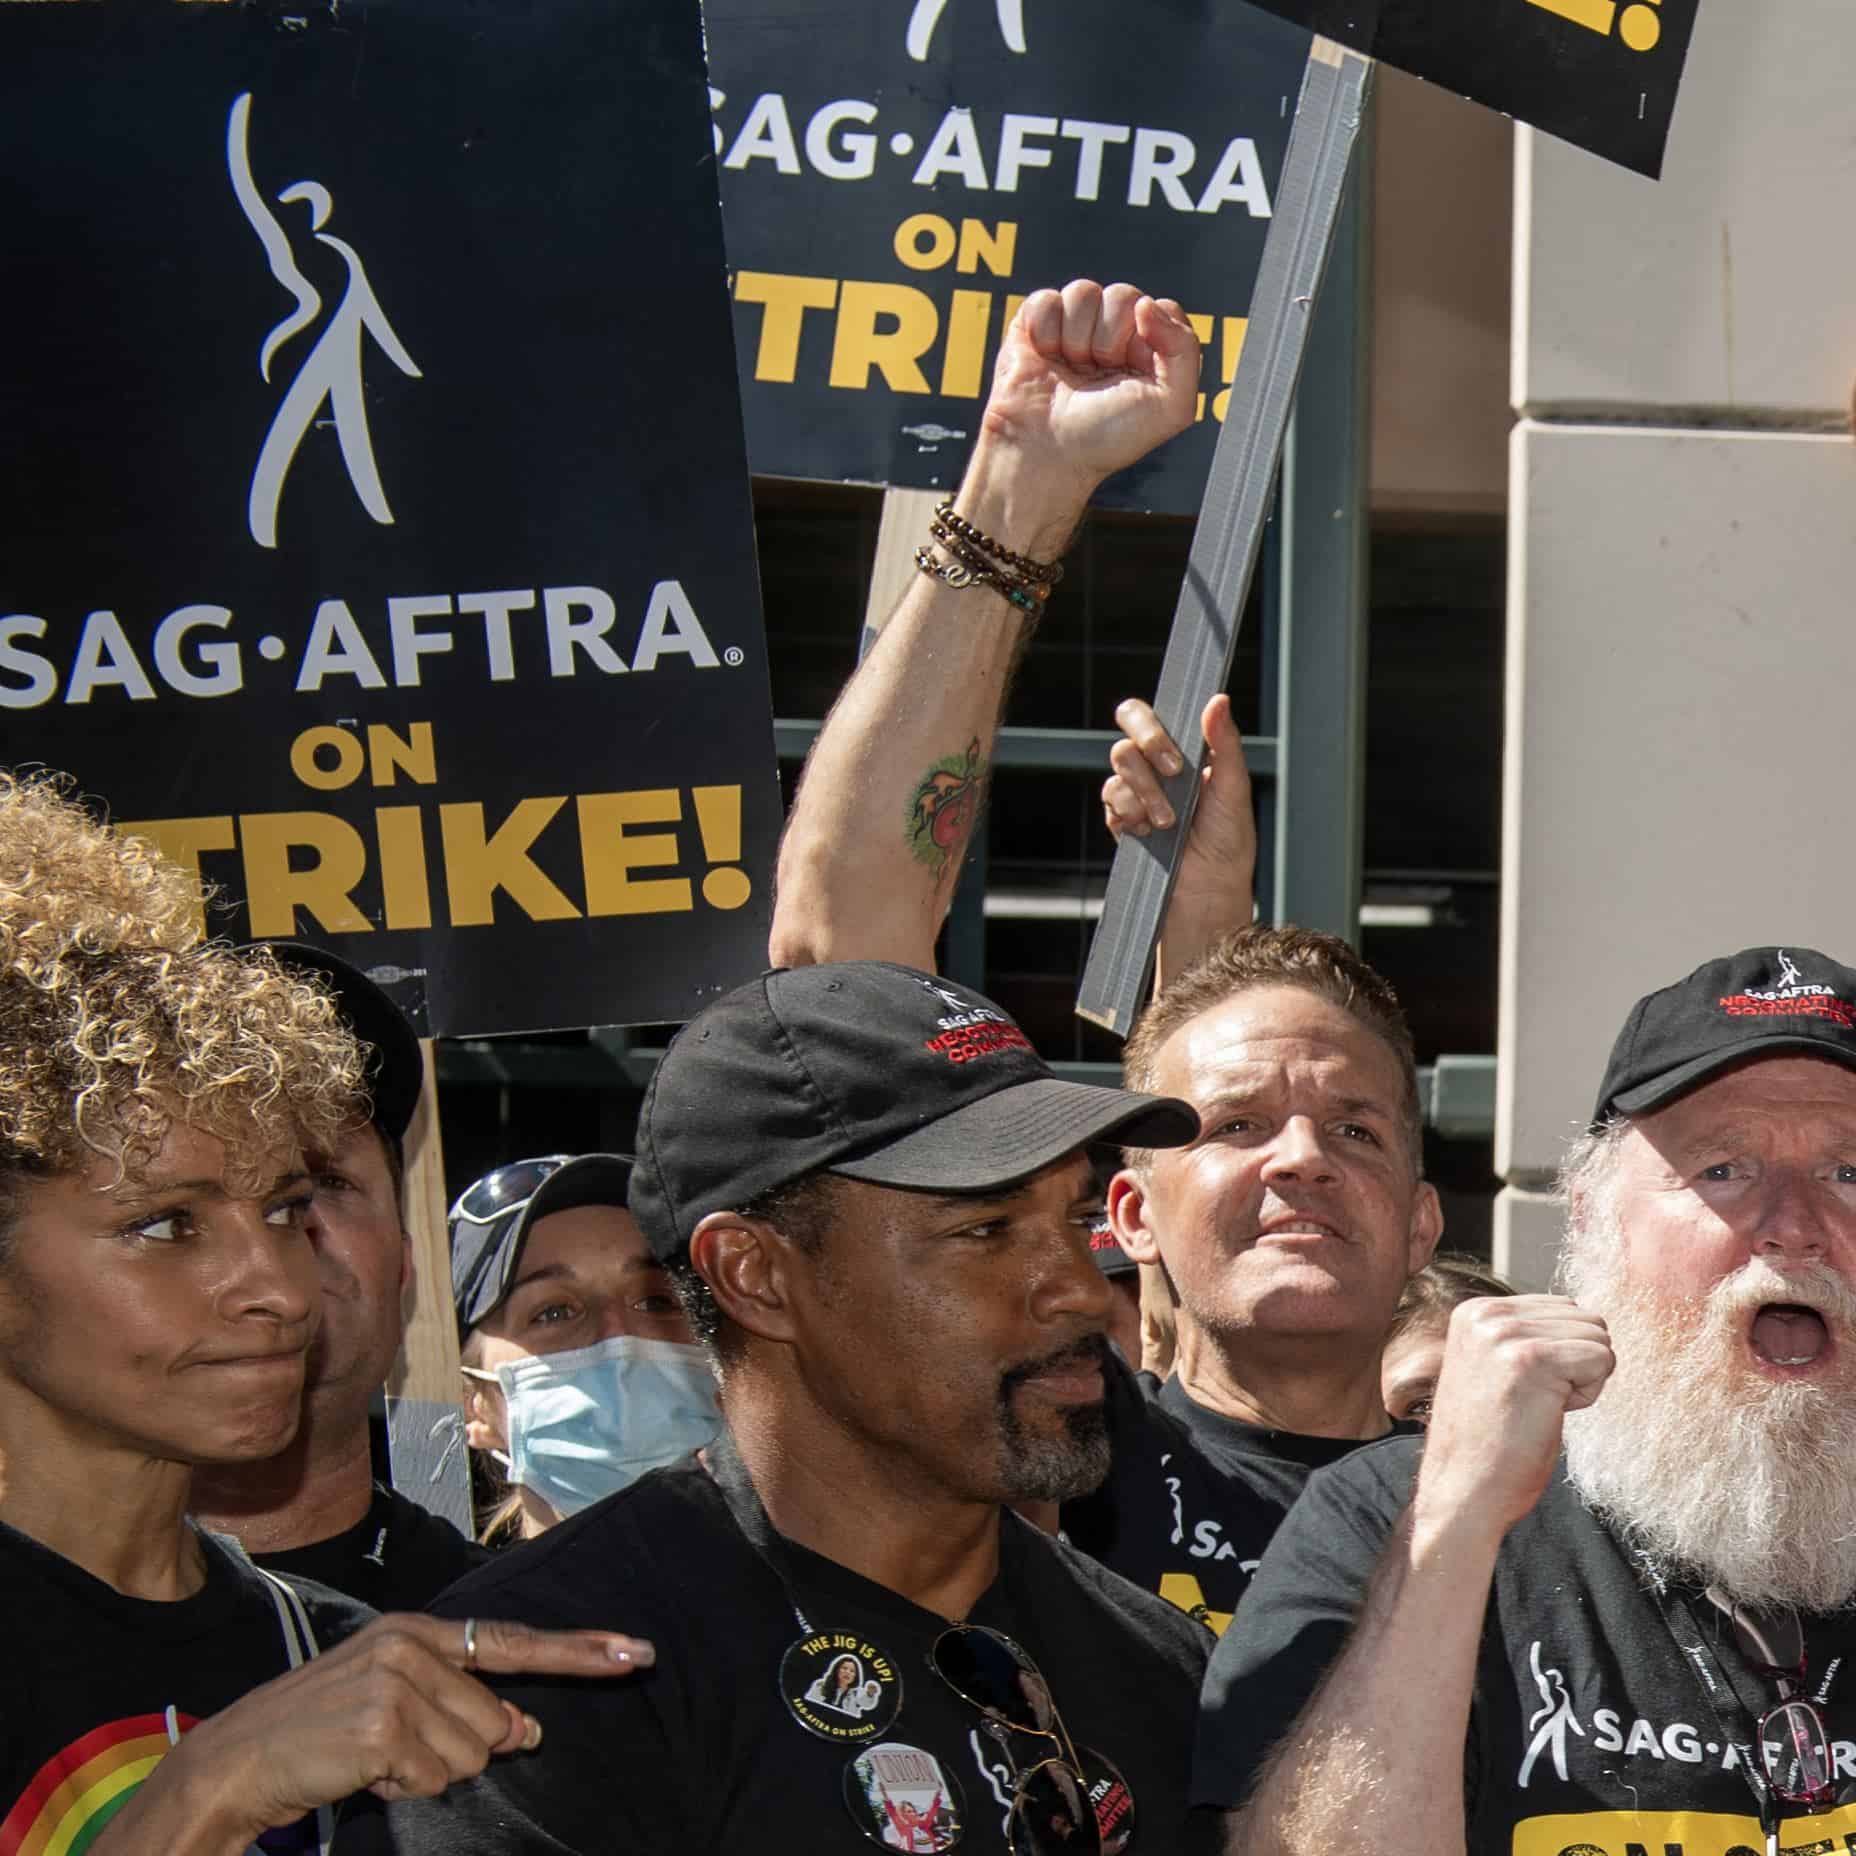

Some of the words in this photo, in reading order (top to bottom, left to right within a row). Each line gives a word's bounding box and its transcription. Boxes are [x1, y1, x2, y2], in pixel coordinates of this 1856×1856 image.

[893, 213, 1018, 278] ON
[290, 721, 437, 791] ON
[113, 785, 752, 940] TRIKE!
[801, 1636, 831, 1656] THE
[833, 1635, 857, 1649] JIG
[859, 1643, 877, 1658] IS
[872, 1658, 895, 1682] UP!
